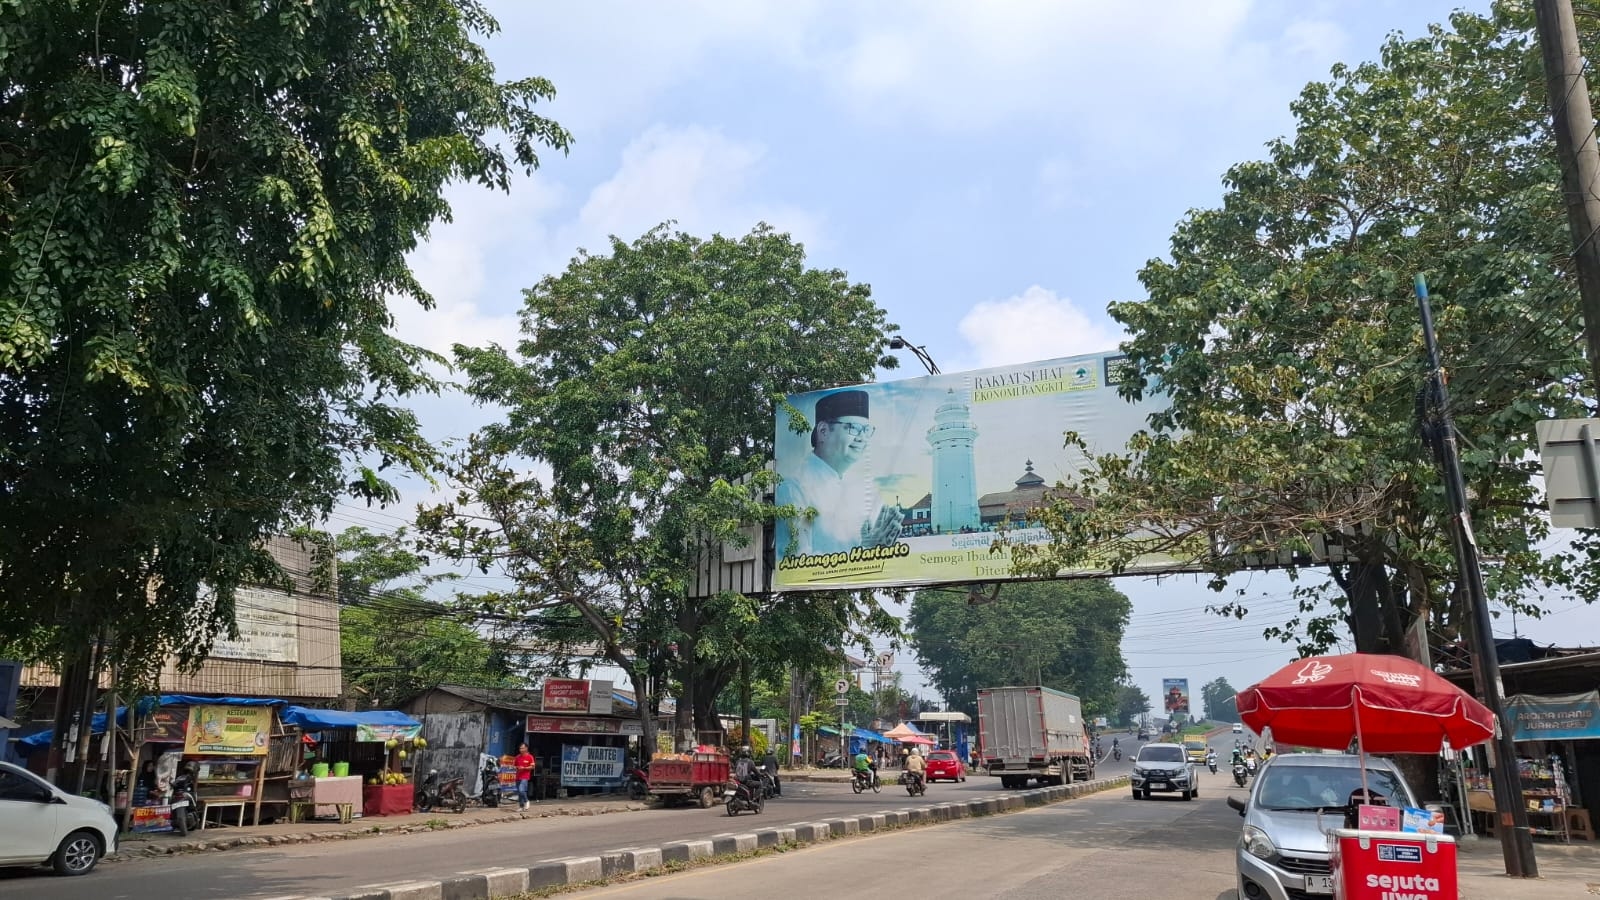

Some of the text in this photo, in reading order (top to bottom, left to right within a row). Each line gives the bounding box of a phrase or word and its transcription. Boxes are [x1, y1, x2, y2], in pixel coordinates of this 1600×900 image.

[975, 366, 1064, 390] RAKYAT SEHAT
[974, 381, 1064, 402] EKONOMI BANGKIT
[779, 541, 910, 570] Airlangga Hartarto
[920, 553, 964, 565] Semoga
[587, 748, 617, 760] WARTEG
[564, 762, 614, 776] CITRA BAHARI
[1308, 876, 1314, 887] A
[1366, 874, 1440, 892] sejuta
